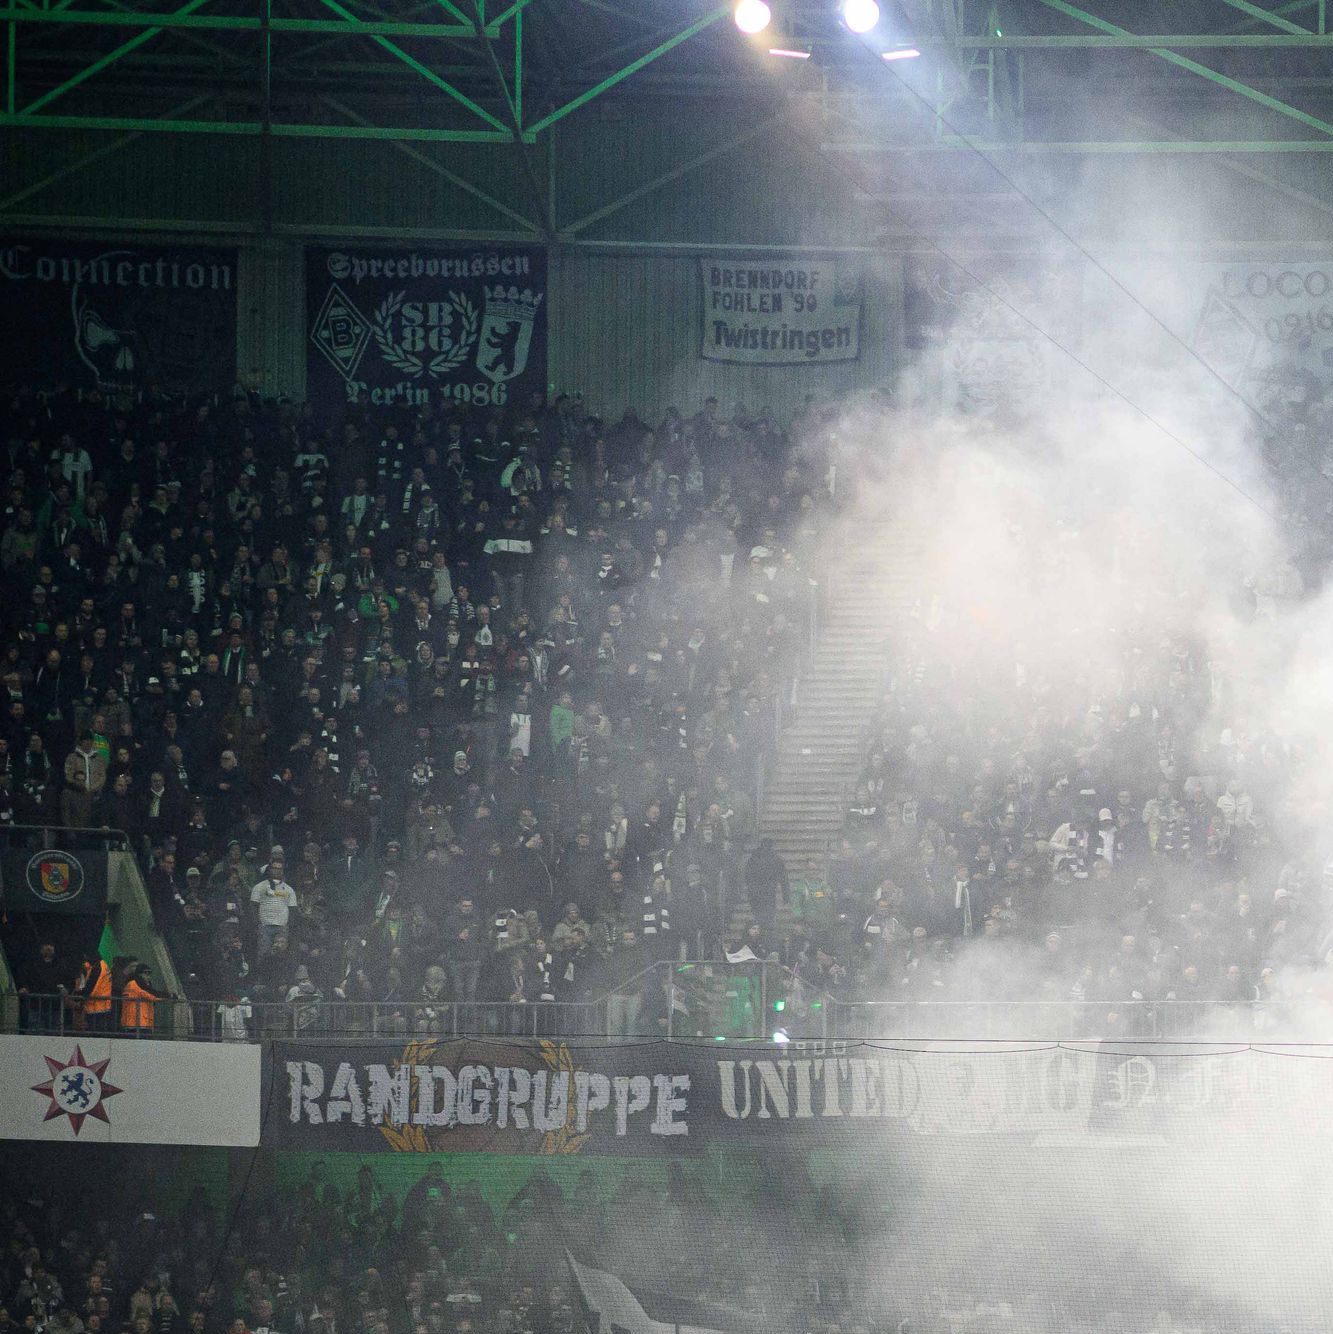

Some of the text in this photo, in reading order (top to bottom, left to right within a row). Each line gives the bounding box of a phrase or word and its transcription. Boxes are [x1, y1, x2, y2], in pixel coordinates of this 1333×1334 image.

[400, 301, 454, 326] SB
[712, 293, 778, 313] FOHLEN
[400, 326, 453, 352] 86
[713, 320, 851, 355] Twistringen
[286, 1057, 691, 1136] RANDGRUPPE
[718, 1059, 918, 1119] UNITED
